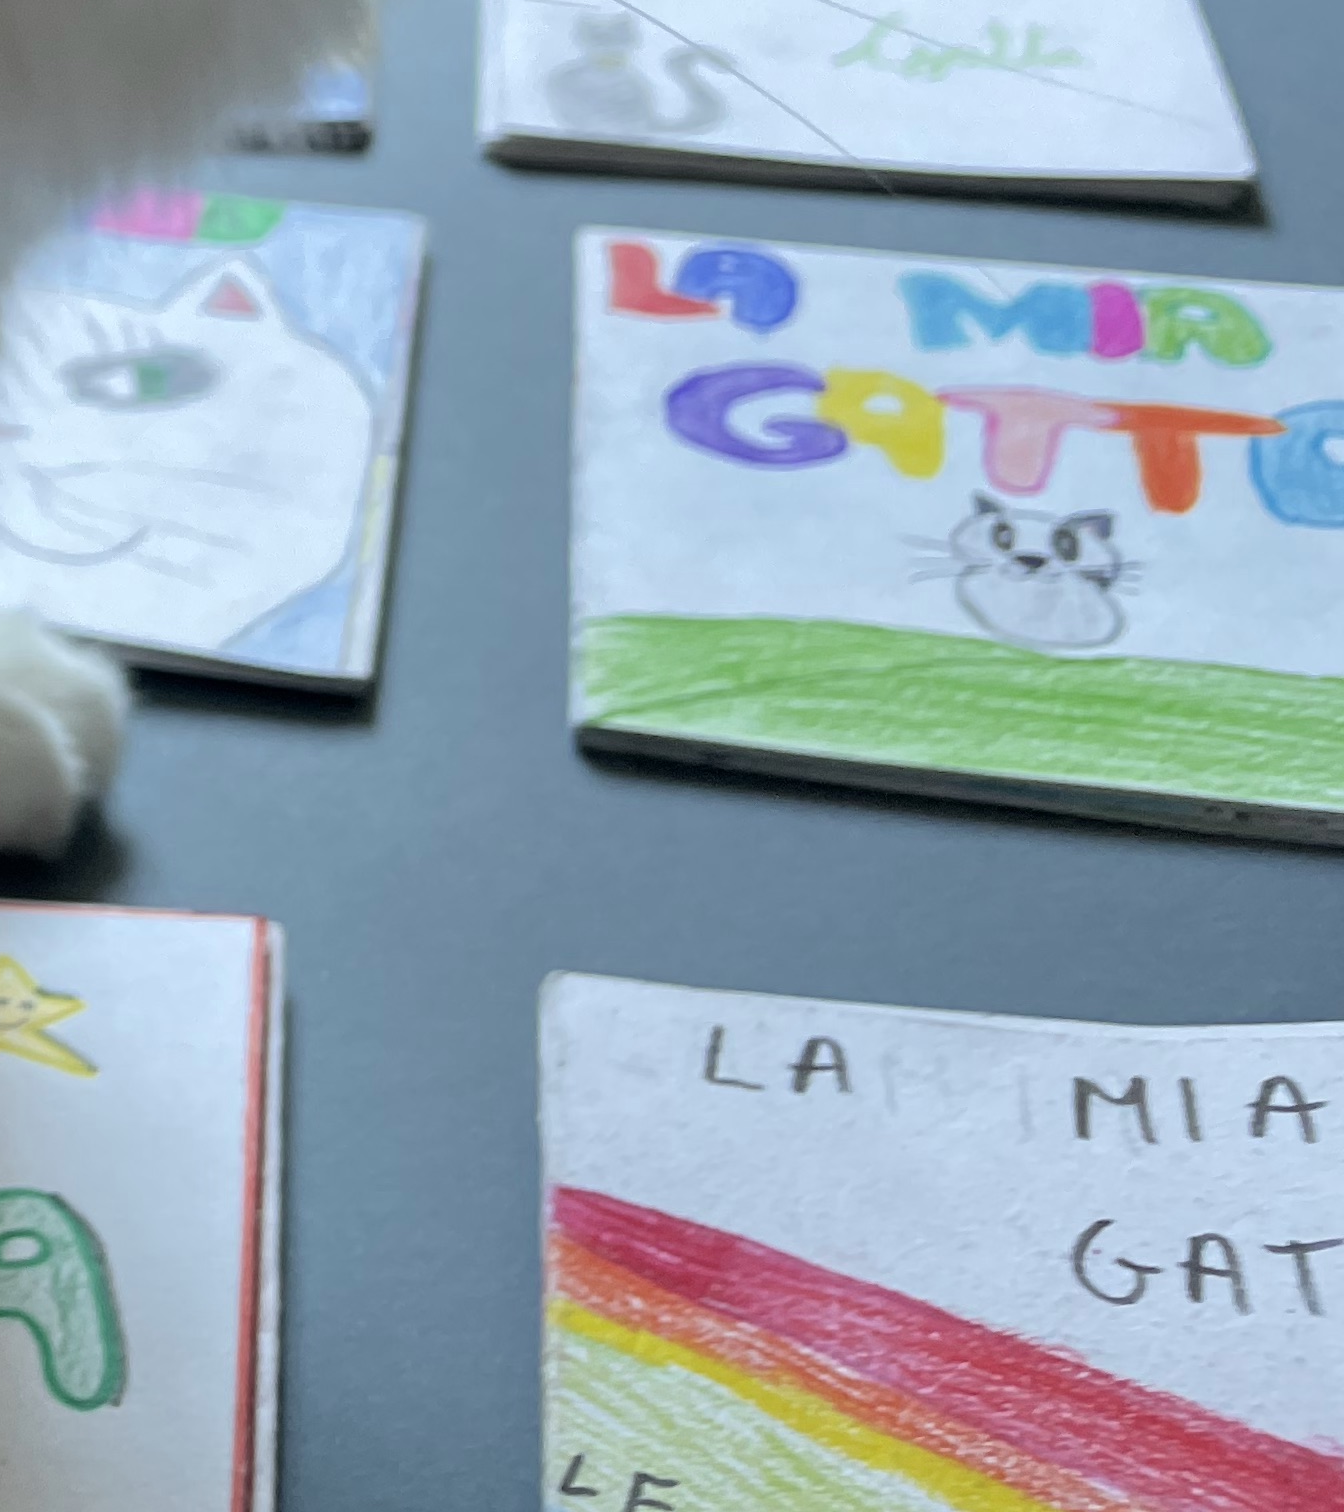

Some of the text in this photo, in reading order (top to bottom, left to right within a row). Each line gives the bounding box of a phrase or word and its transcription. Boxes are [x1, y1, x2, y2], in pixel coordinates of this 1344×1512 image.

[607, 239, 1273, 368] LA MIA
[702, 1026, 1328, 1145] LA MIA
